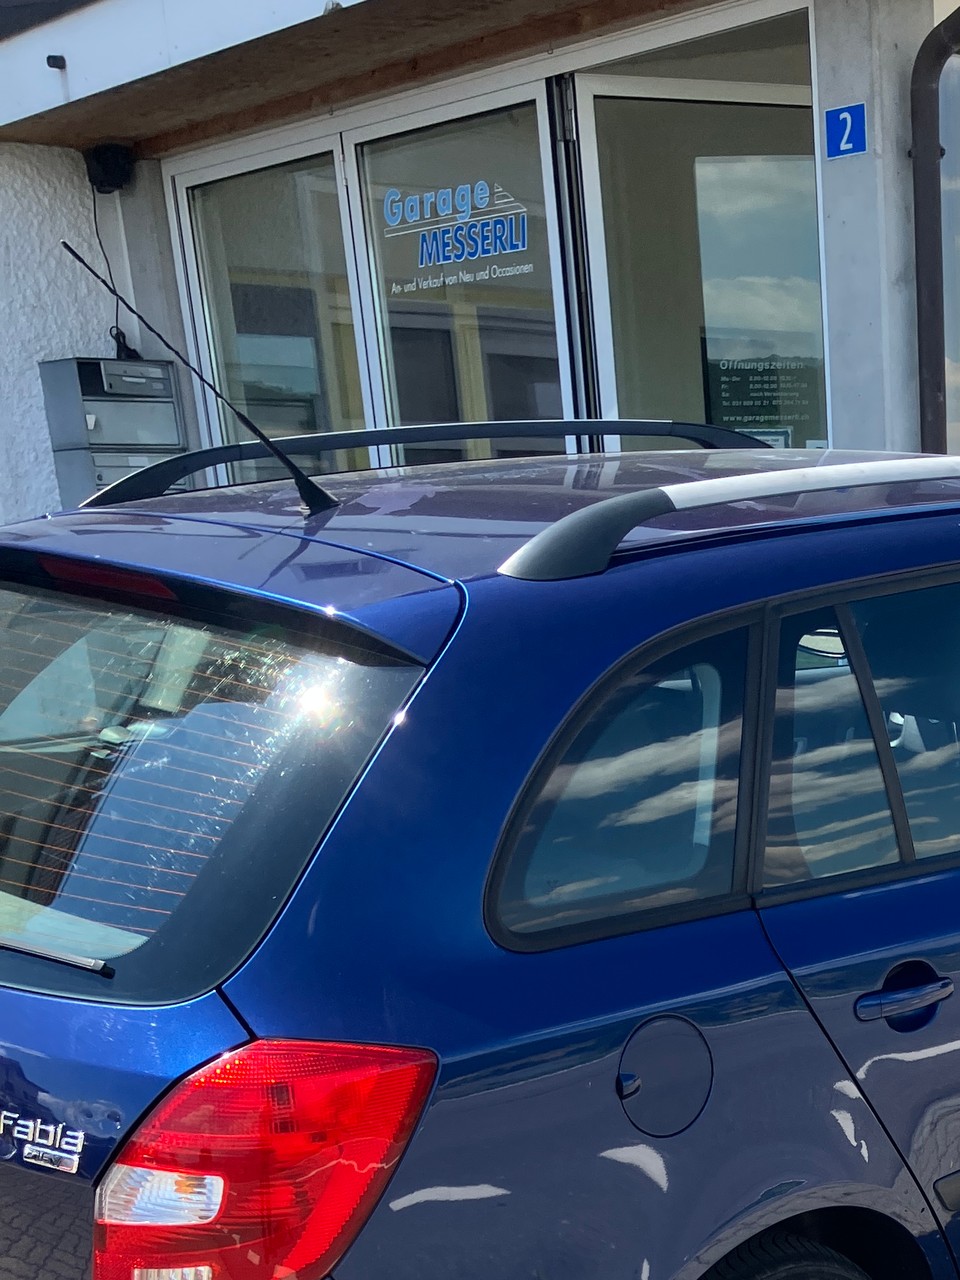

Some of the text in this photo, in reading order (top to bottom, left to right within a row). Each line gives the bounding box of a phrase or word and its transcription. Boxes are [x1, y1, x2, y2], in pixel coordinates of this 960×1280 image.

[839, 112, 853, 150] 2
[383, 180, 490, 226] Garage
[418, 213, 528, 268] MESSERLI
[403, 278, 417, 293] und
[418, 273, 444, 290] Verkauf
[444, 275, 458, 286] von
[459, 270, 474, 283] Neu
[475, 266, 489, 280] und
[490, 263, 534, 278] Occasionen
[0, 1110, 84, 1152] Fabia
